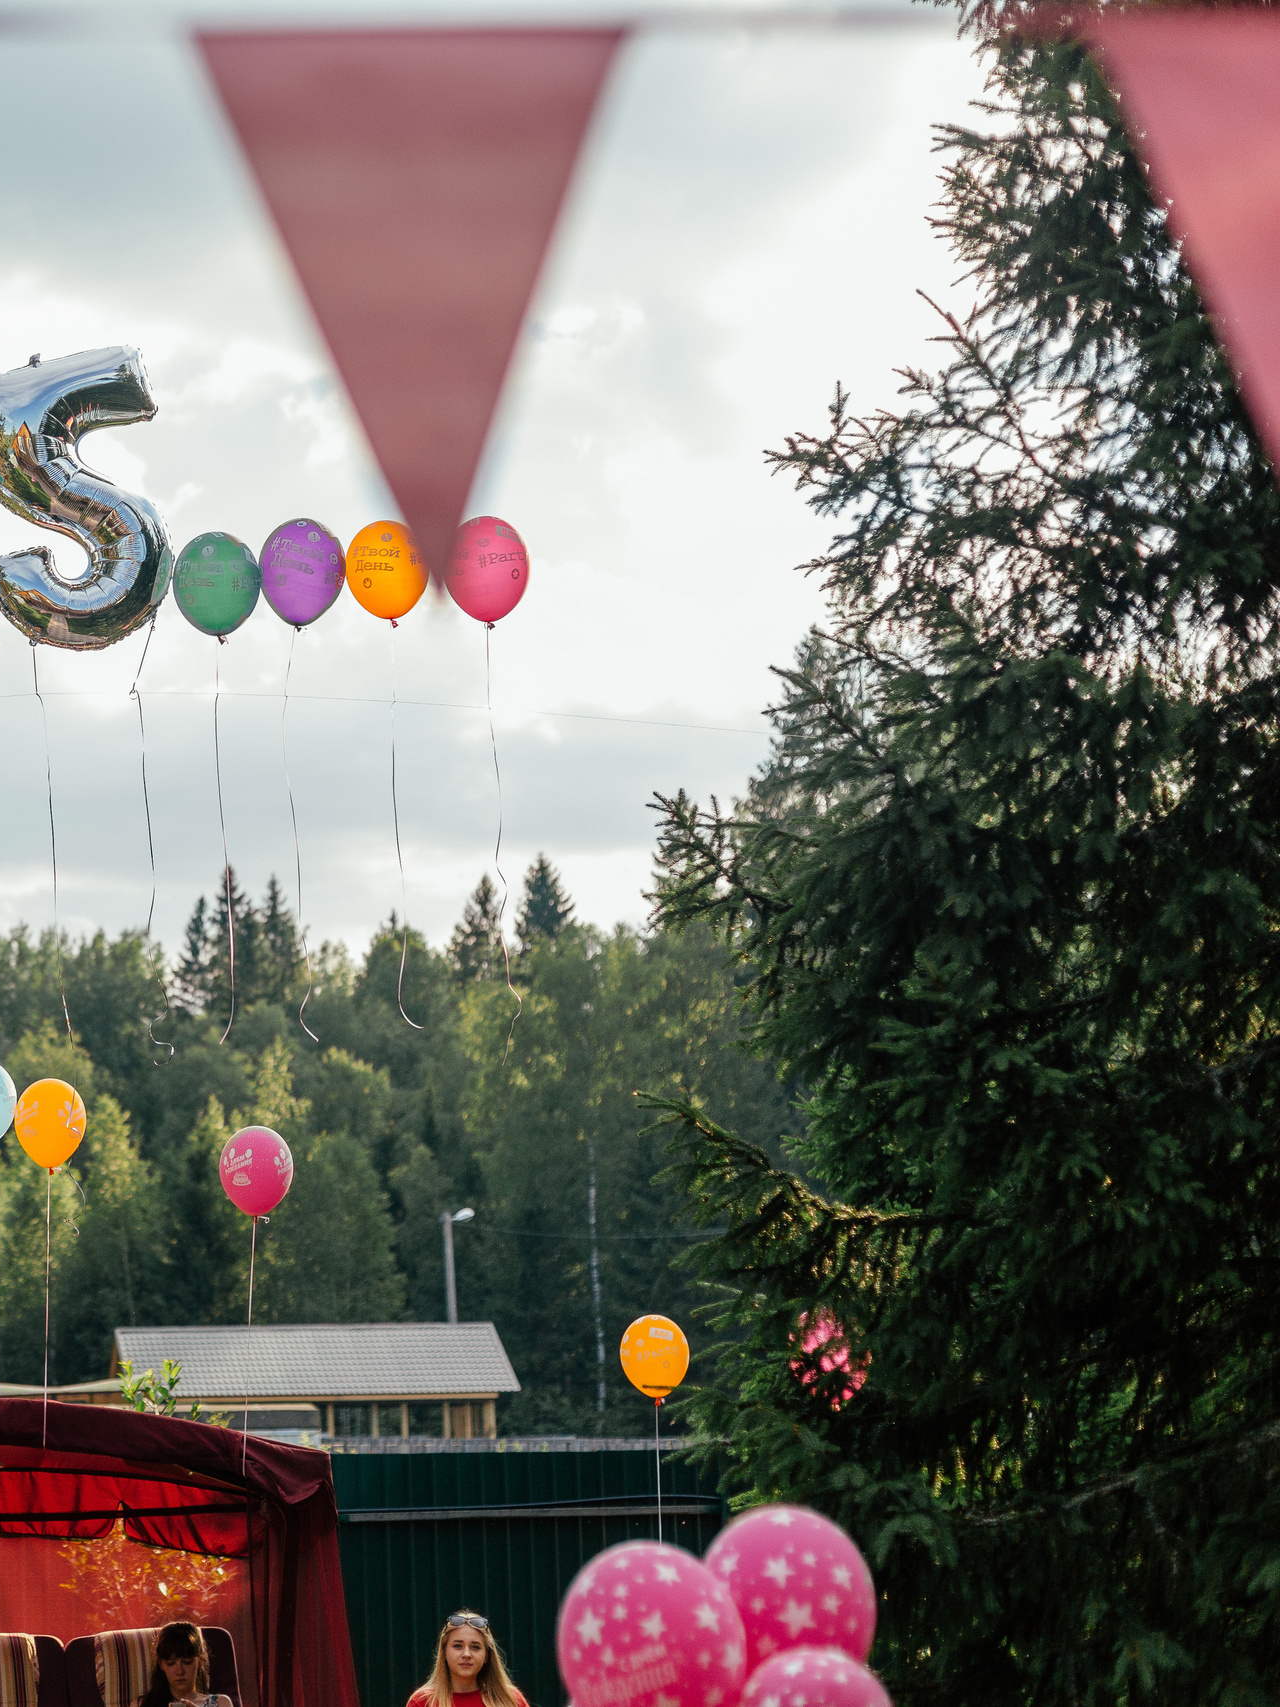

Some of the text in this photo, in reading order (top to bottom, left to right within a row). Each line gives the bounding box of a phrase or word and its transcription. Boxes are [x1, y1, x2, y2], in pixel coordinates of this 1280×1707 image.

[270, 536, 325, 562] #Твой
[352, 546, 401, 559] #Твой
[270, 552, 315, 575] День
[354, 560, 394, 573] День
[637, 1345, 678, 1362] #Party
